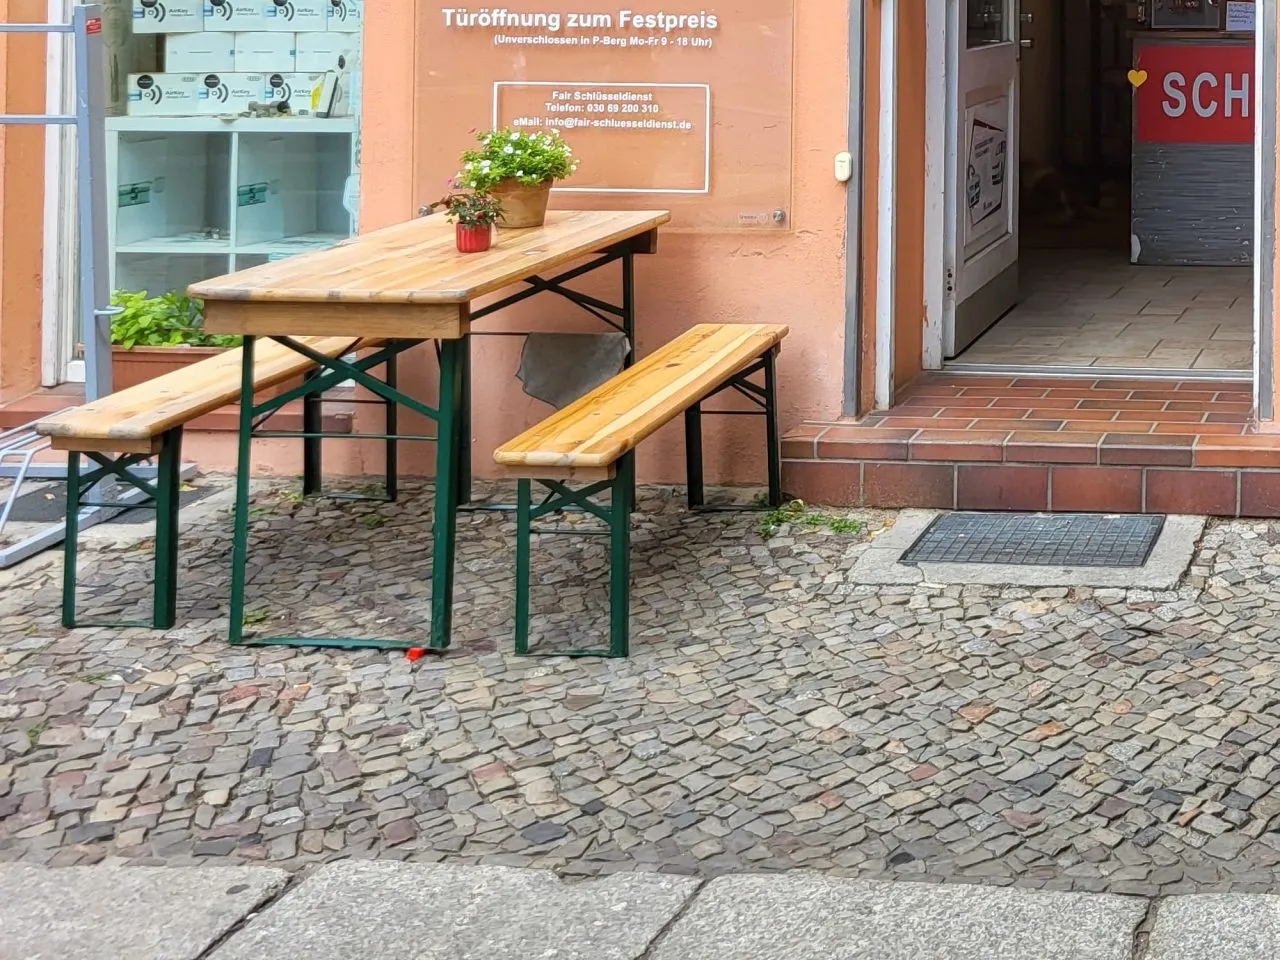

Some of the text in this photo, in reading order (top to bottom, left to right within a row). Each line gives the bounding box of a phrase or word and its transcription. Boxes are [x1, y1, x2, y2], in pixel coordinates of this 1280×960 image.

[441, 8, 718, 32] Türöffnung zum Festpreis
[494, 34, 578, 45] (Unverschlossen
[580, 36, 590, 45] in
[592, 36, 627, 47] P-Berg
[629, 36, 658, 46] Mo-Fr
[661, 37, 668, 45] 9
[677, 37, 688, 46] 18
[691, 37, 713, 48] Uhr)
[552, 91, 653, 101] Fair Schlüsseldienst
[1162, 72, 1250, 118] SCH
[545, 102, 659, 113] Telefon: 030 69 200 310
[513, 117, 692, 129] eMail: info@fair-schluesseldienst.de
